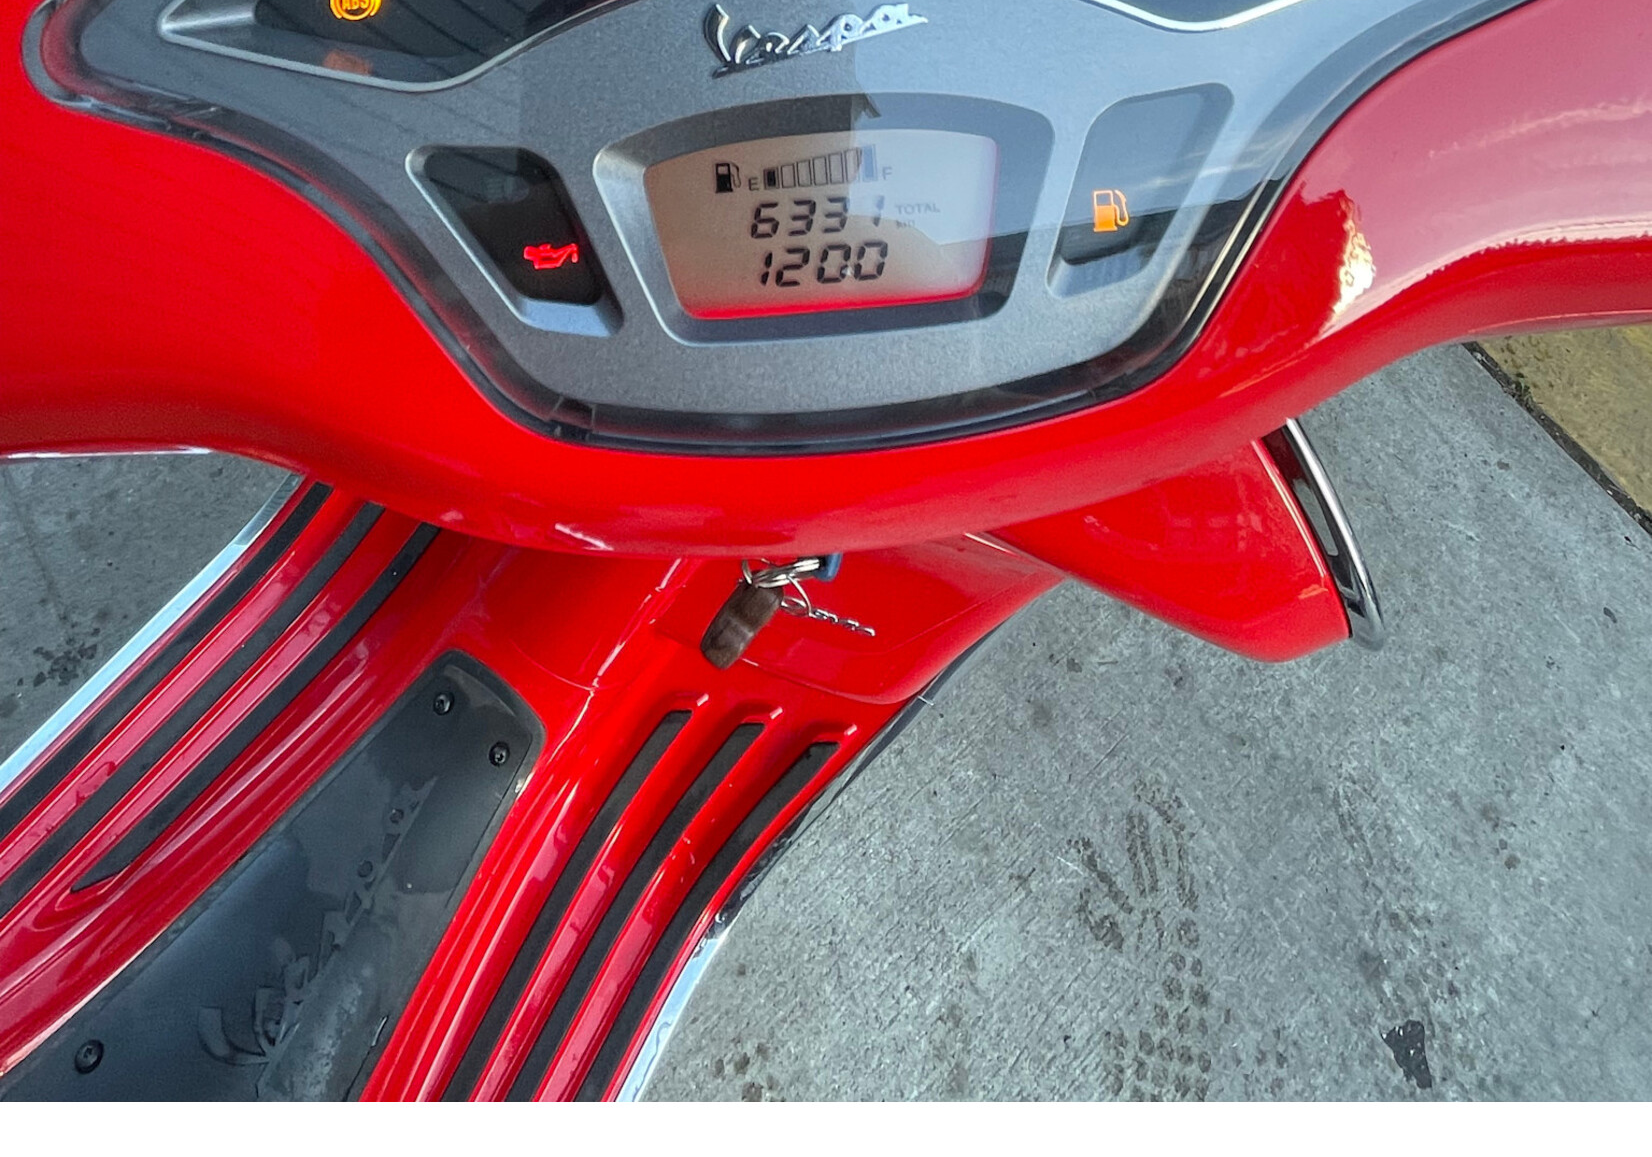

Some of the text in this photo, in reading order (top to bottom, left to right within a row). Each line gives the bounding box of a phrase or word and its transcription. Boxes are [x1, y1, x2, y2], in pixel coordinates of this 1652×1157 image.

[703, 3, 929, 79] Vespa
[748, 176, 760, 192] E
[751, 195, 941, 240] 6331 TOTAL
